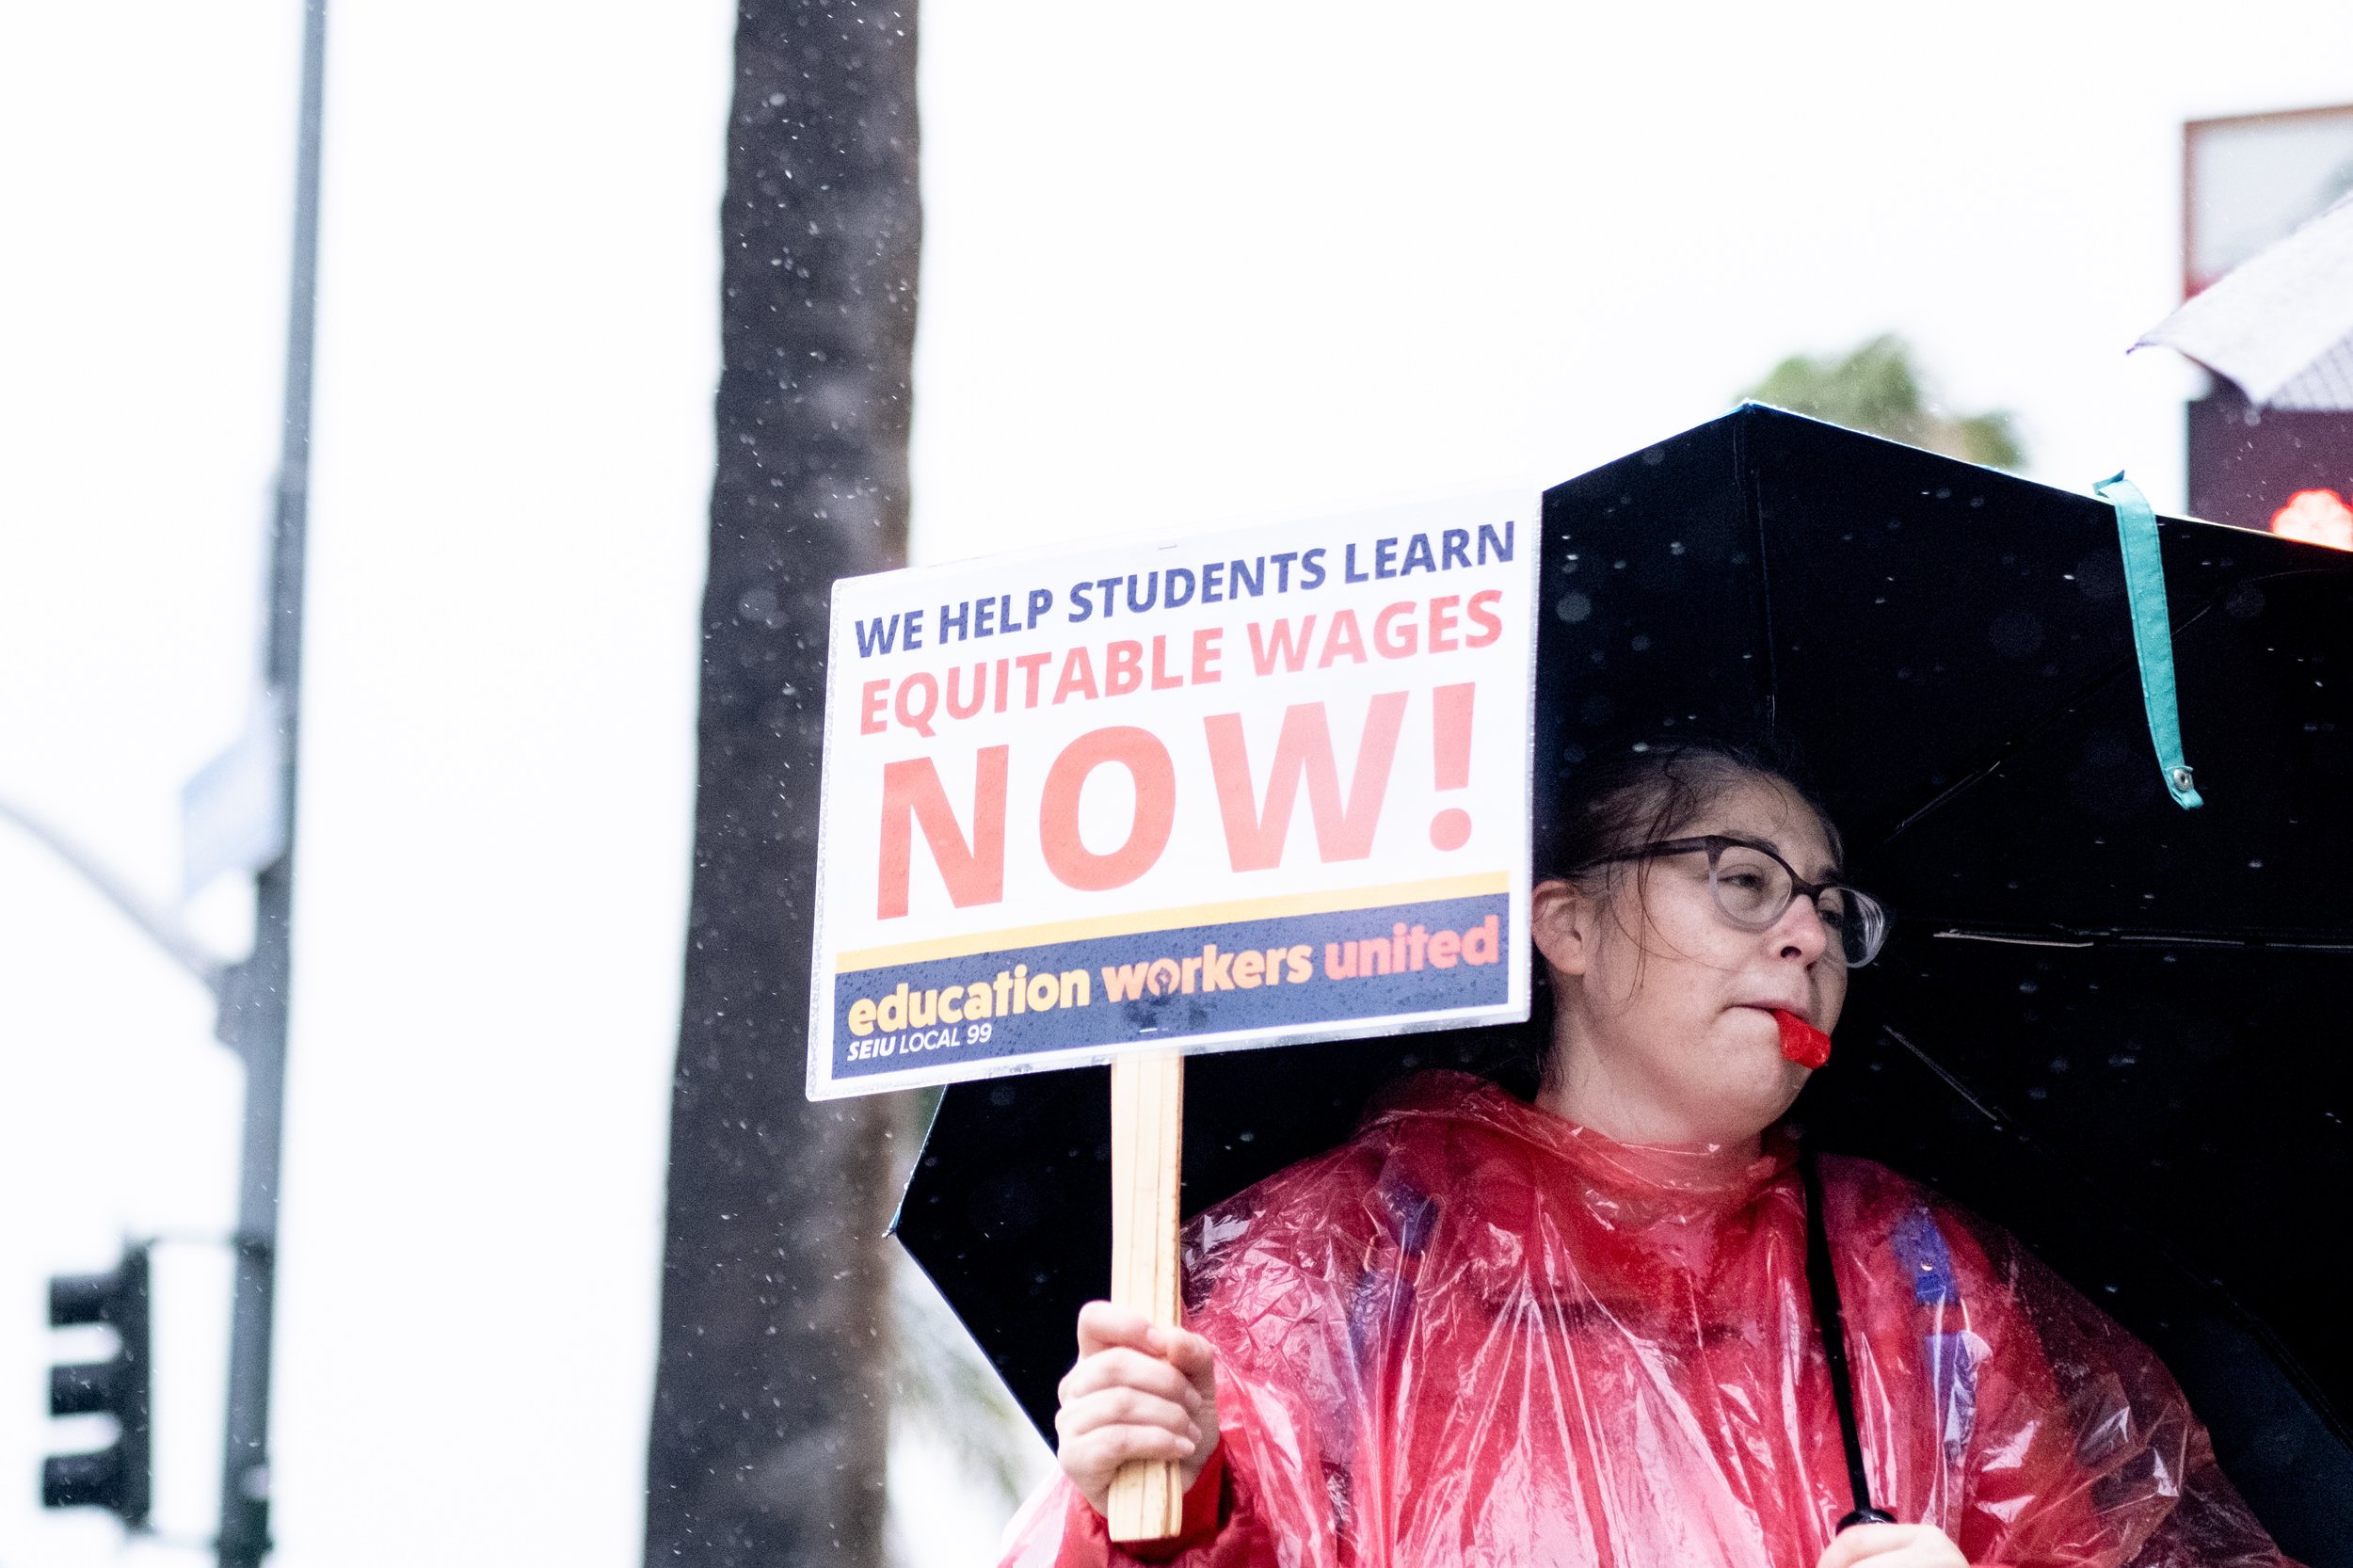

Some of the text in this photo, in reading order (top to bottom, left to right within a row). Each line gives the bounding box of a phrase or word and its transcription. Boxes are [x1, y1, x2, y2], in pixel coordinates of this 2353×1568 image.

[854, 520, 1515, 659] WE HELP STUDENTS LEARN
[859, 589, 1504, 737] EQUITABLE WAGES
[877, 681, 1476, 920] NOW!
[846, 1023, 992, 1061] SEIU LOCAL 99
[848, 914, 1499, 1036] education workers united
